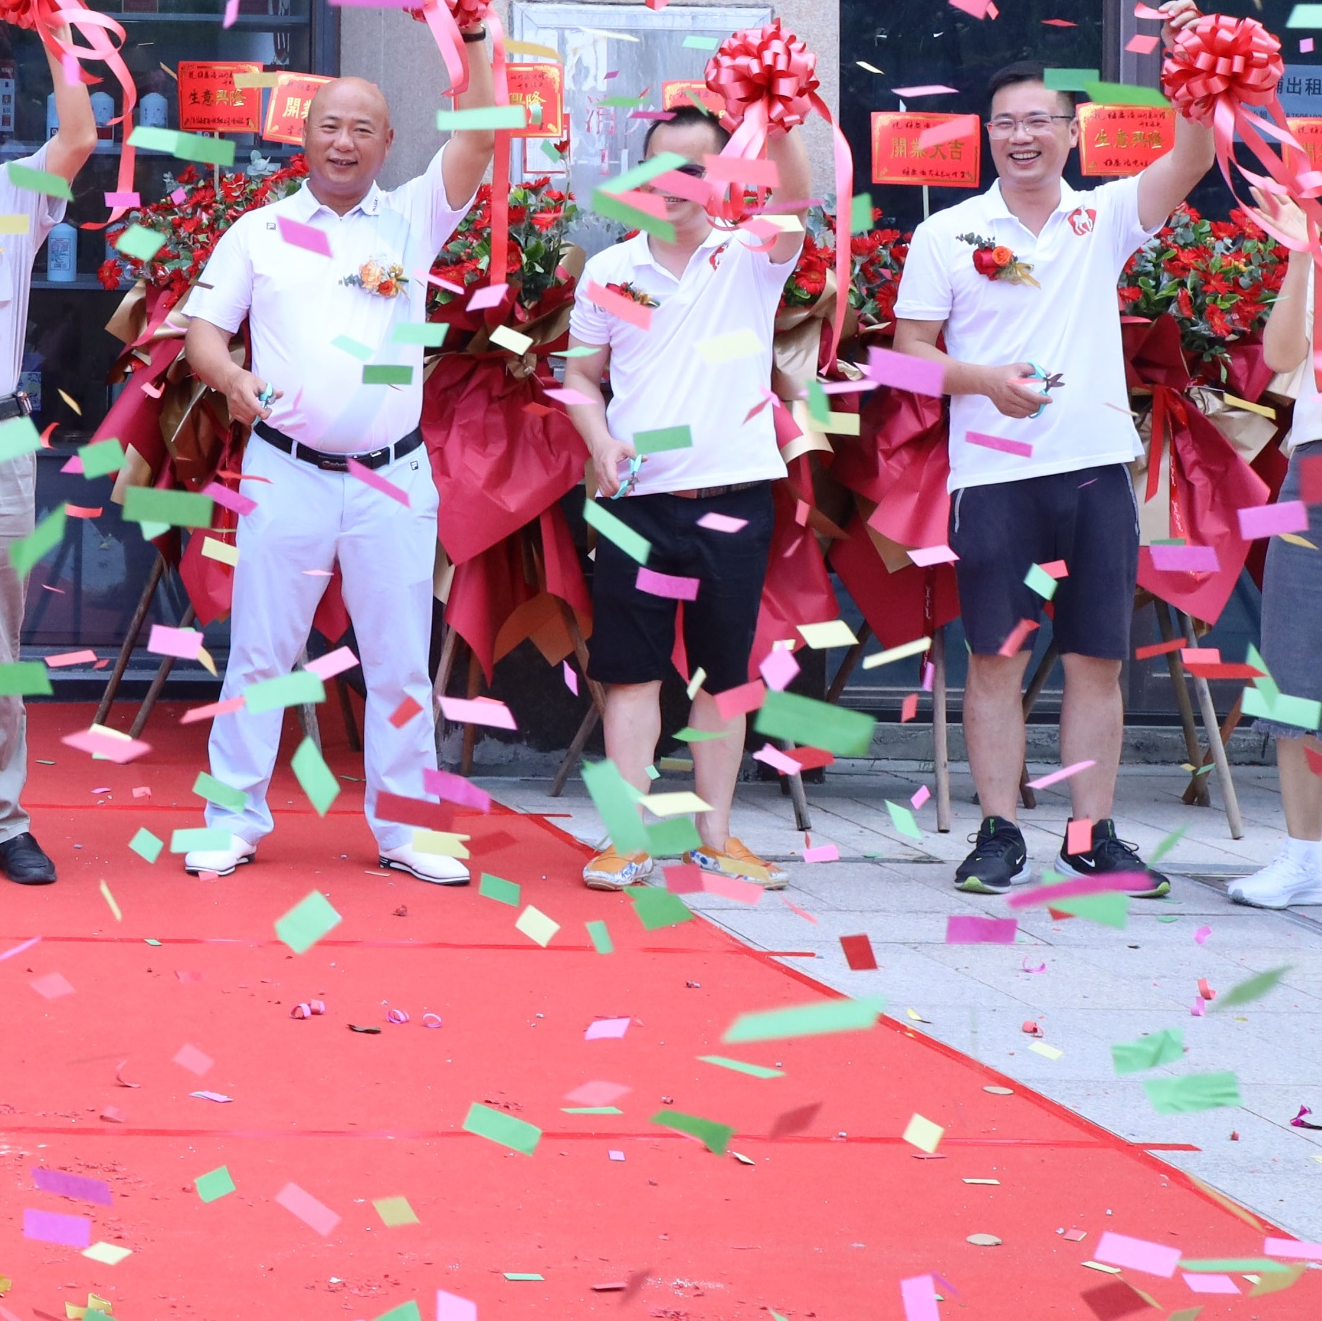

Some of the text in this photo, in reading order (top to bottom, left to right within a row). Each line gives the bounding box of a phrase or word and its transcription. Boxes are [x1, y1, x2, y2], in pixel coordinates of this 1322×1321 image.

[1277, 76, 1322, 96] 出租
[188, 88, 247, 107] 生意興隆
[1095, 128, 1163, 149] 生意興隆
